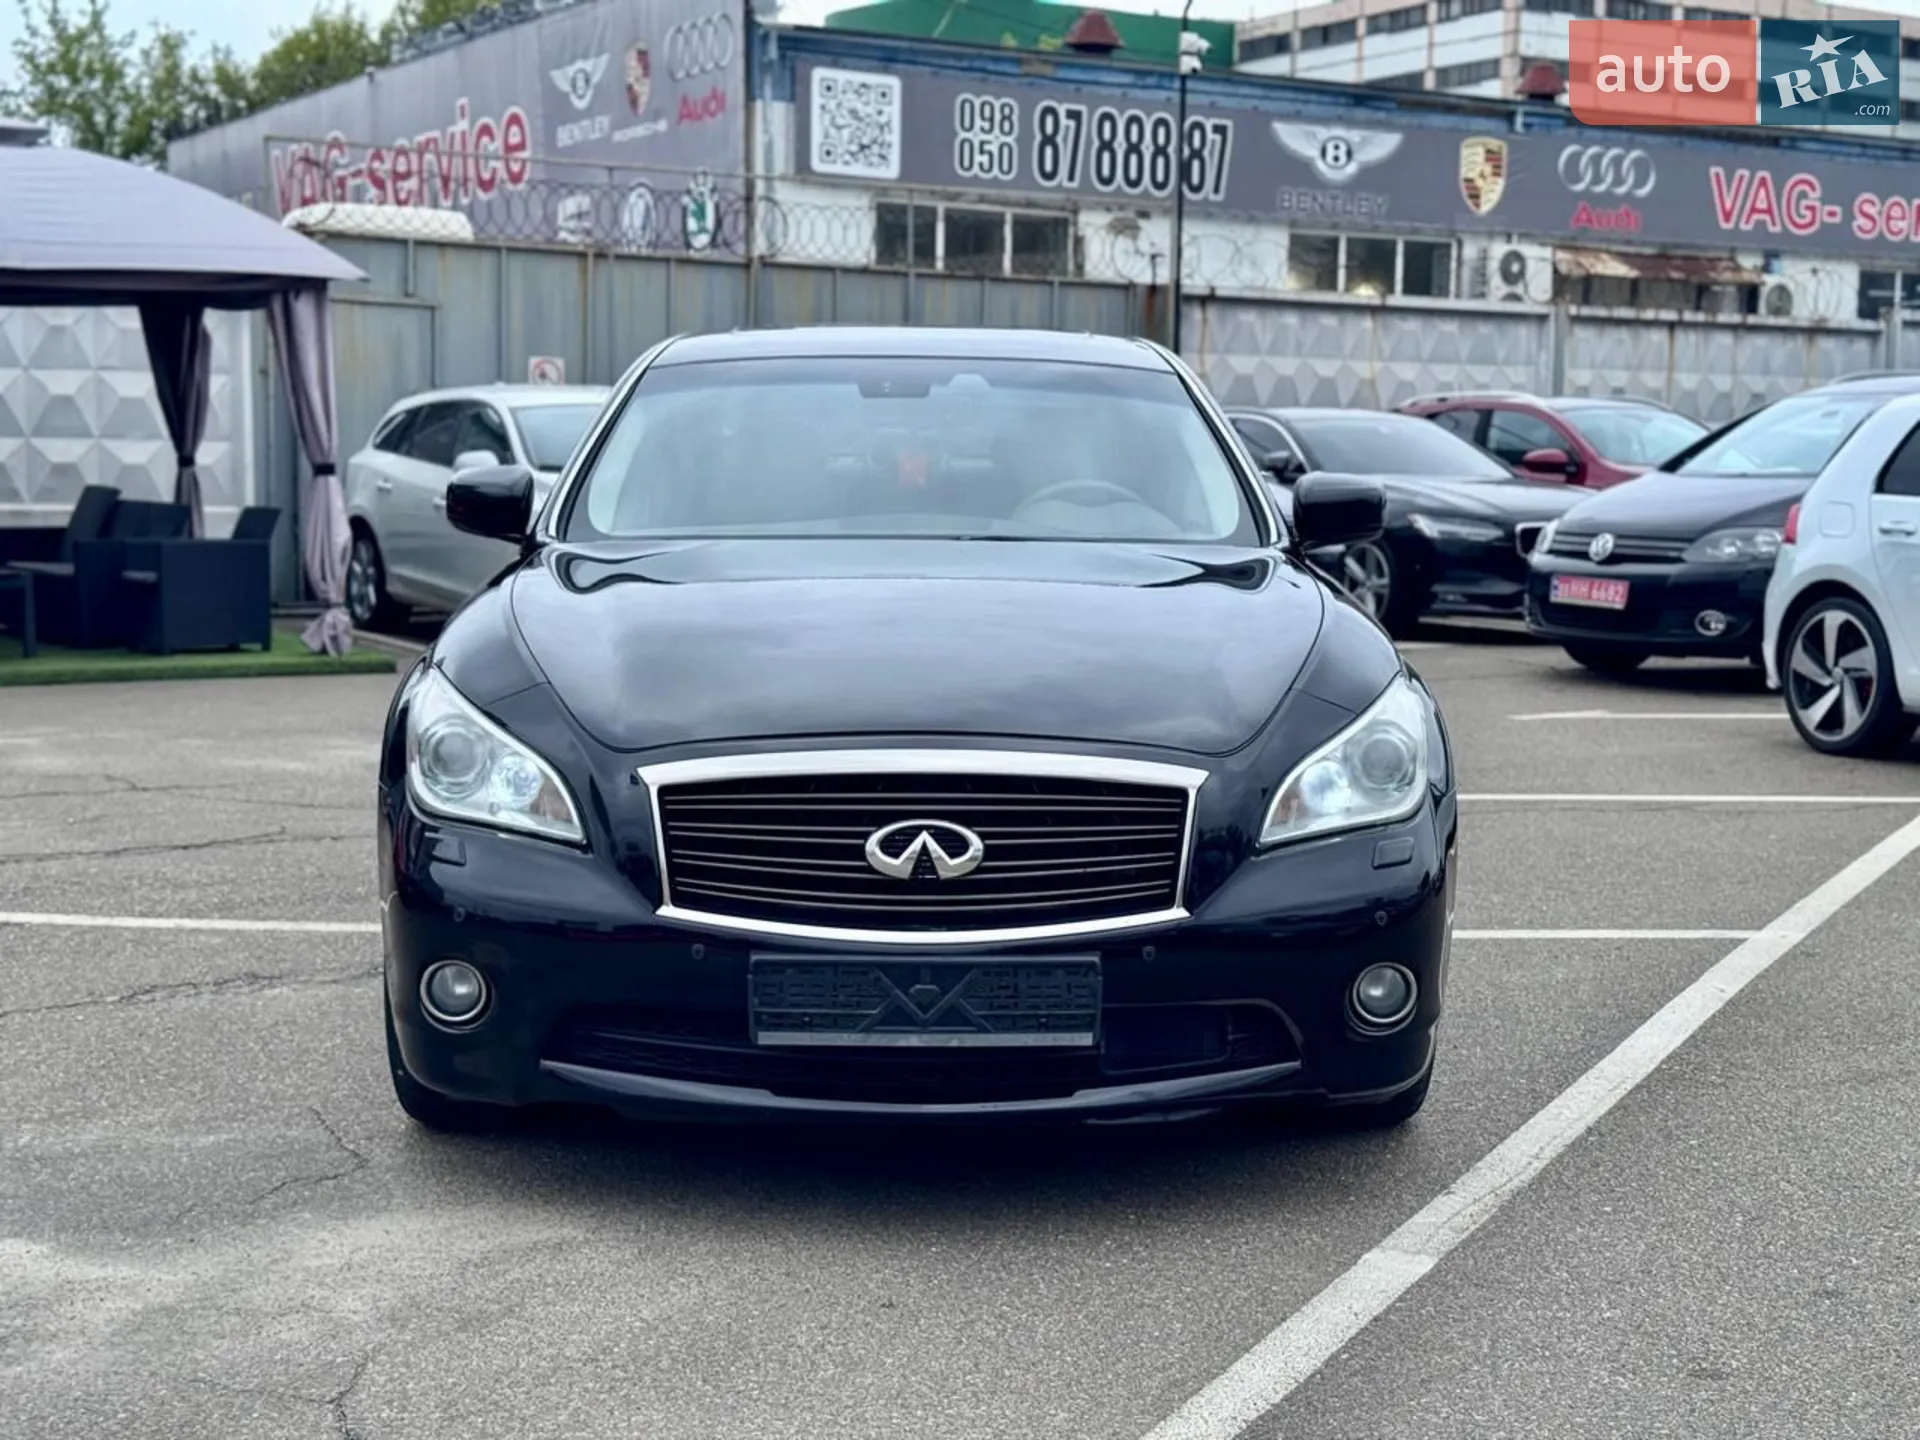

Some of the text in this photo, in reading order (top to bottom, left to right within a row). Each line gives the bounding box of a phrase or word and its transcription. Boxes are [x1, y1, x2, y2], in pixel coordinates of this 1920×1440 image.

[676, 85, 728, 126] Audi
[955, 93, 1018, 138] 098
[556, 115, 611, 149] BENTLEY
[954, 135, 1018, 180] 050
[1278, 187, 1389, 217] BENTLEY
[1570, 200, 1642, 232] Audi
